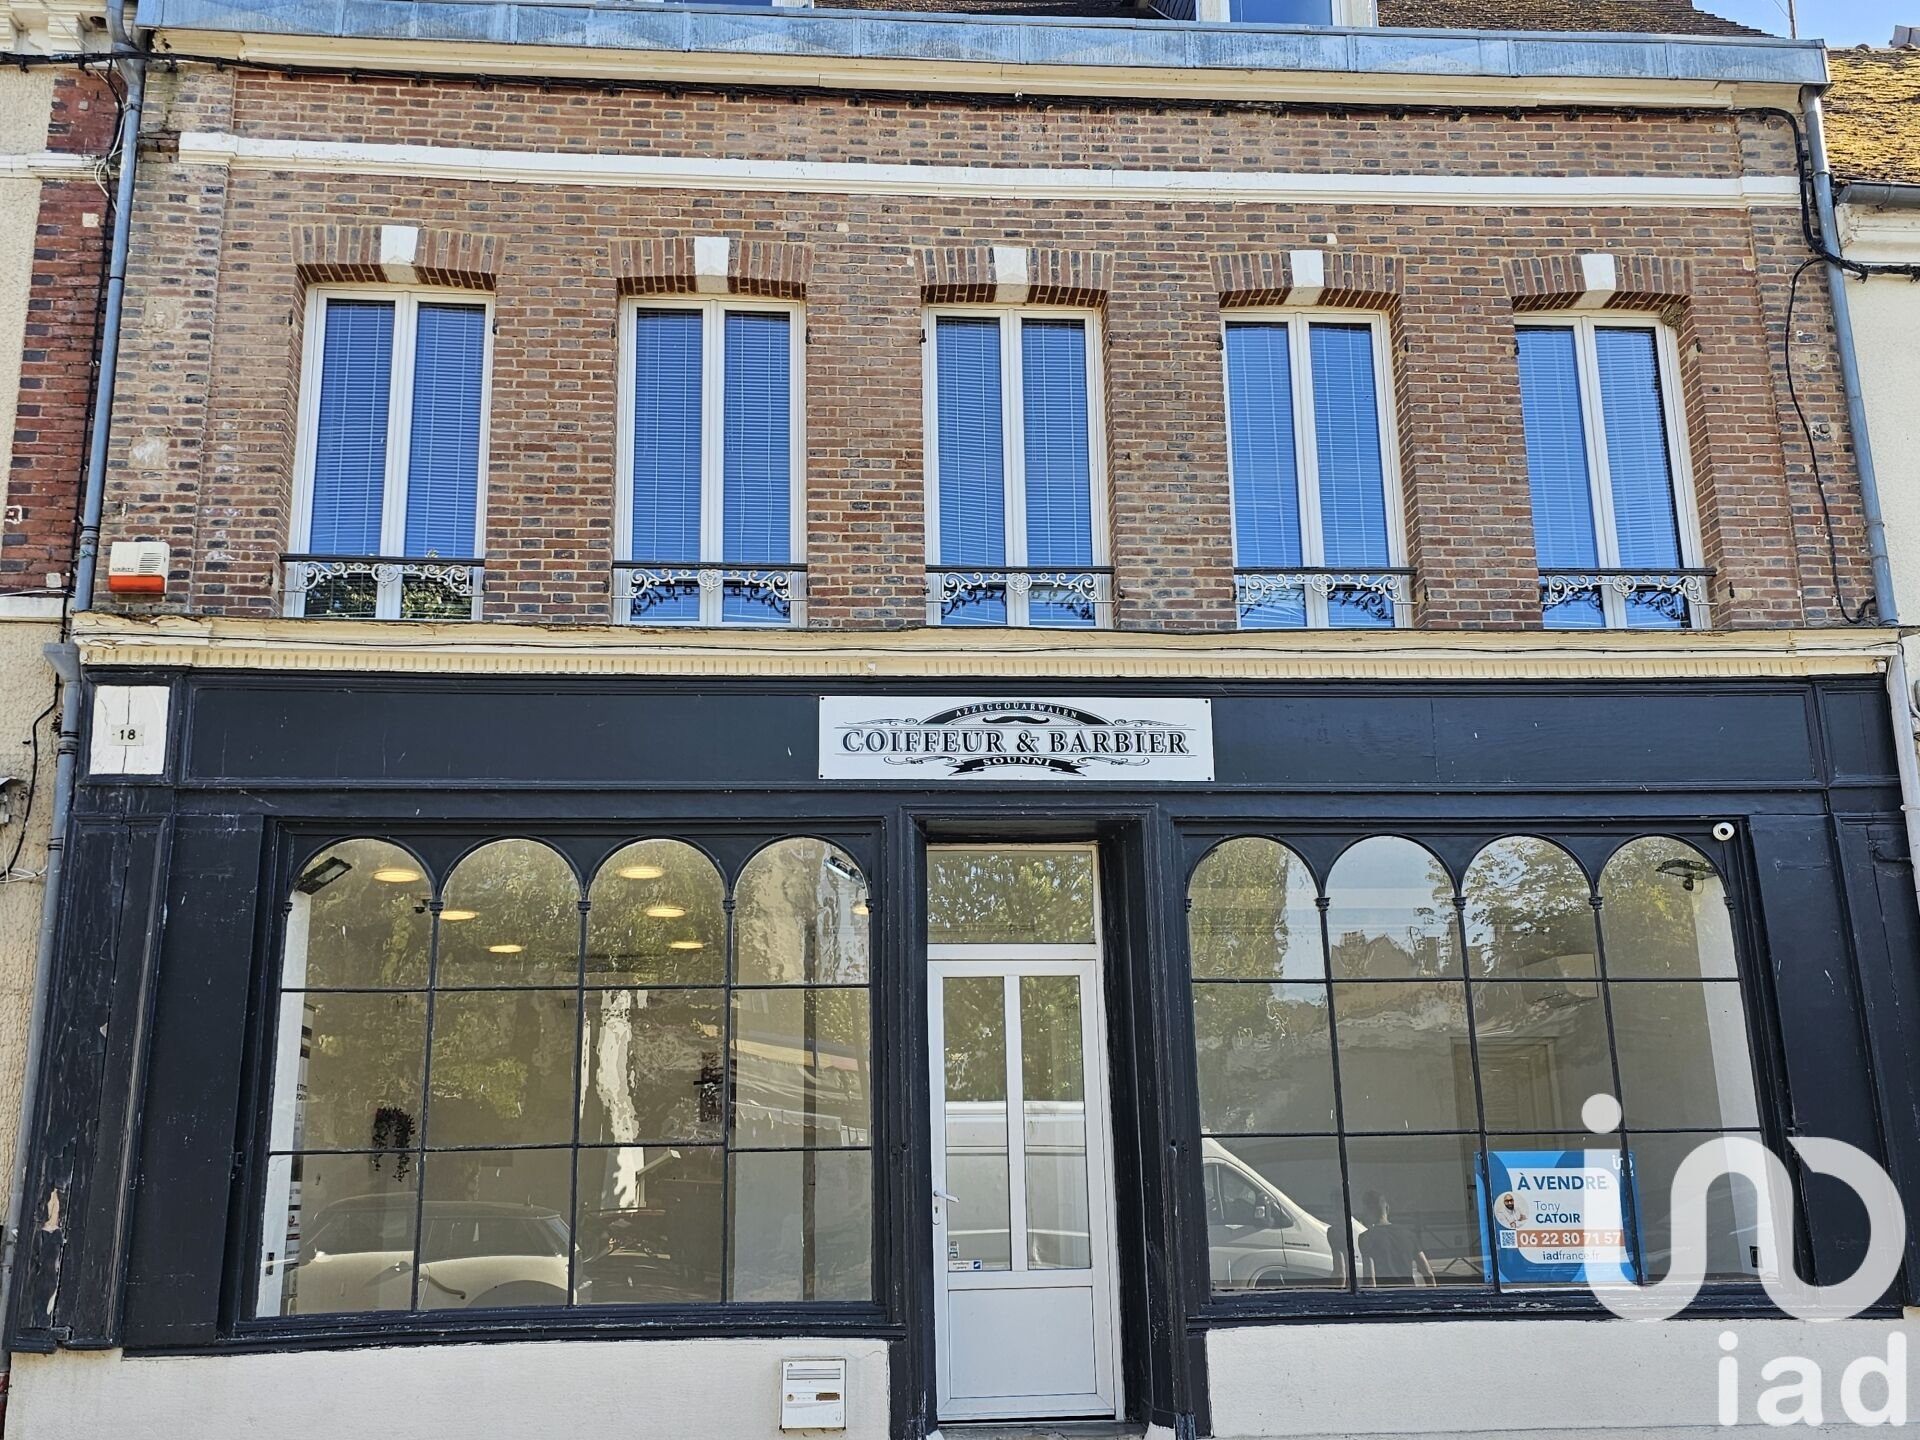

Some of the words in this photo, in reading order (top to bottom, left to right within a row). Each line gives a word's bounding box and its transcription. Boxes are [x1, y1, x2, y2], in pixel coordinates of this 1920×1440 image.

[120, 729, 136, 740] 18
[842, 730, 1005, 753] COIFFEUR
[1017, 731, 1040, 753] &
[1049, 731, 1190, 754] BARBIER
[982, 756, 1051, 766] SOUNNI
[1517, 1173, 1531, 1190] À
[1533, 1175, 1607, 1190] VENDRE
[1534, 1201, 1561, 1213] Tony
[1535, 1213, 1581, 1223] CATOIR
[1520, 1233, 1538, 1245] 06
[1541, 1233, 1559, 1245] 22
[1562, 1233, 1580, 1245] 80
[1583, 1233, 1600, 1245] 71
[1604, 1232, 1621, 1244] 57
[1543, 1251, 1600, 1261] iadfrance.fr
